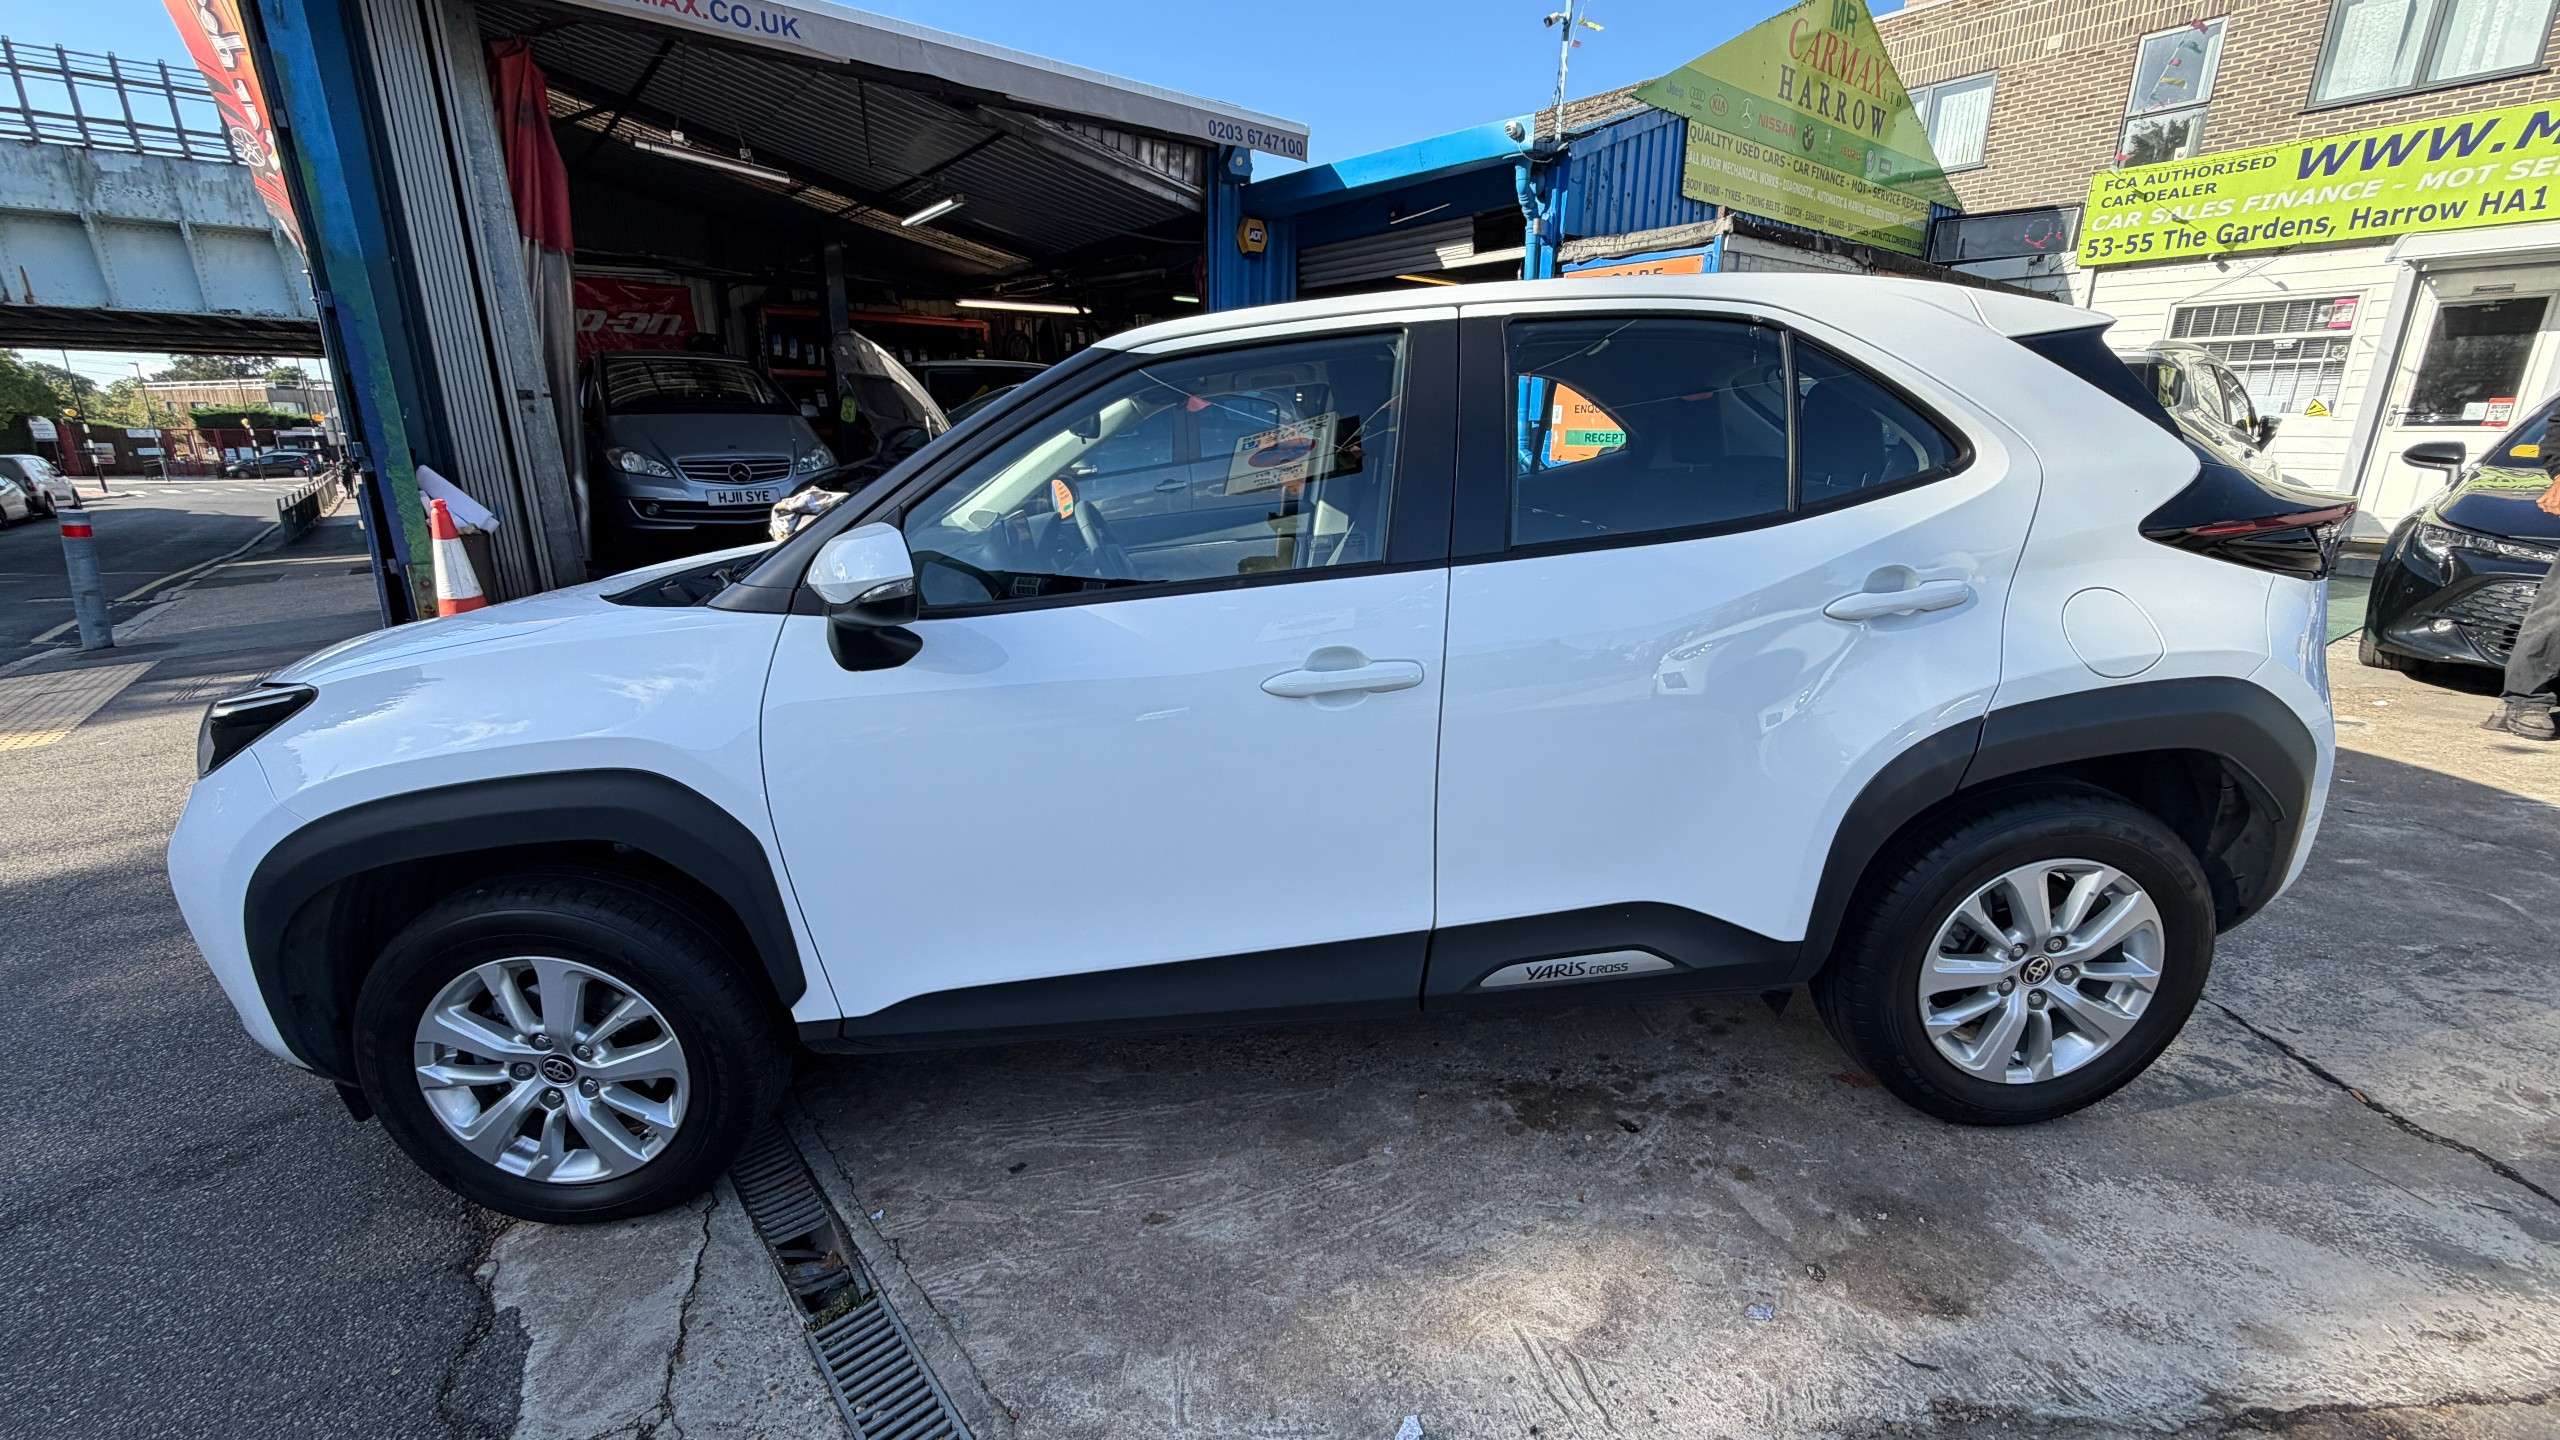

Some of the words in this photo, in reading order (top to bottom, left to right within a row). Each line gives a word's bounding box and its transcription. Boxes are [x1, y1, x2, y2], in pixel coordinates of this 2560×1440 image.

[642, 0, 801, 39] AX.CO.UK
[1831, 0, 1858, 39] MR
[1789, 17, 1889, 99] CARMAX
[1883, 87, 1902, 107] LTD
[1778, 64, 1887, 138] HARROW
[1208, 119, 1243, 142] 0203
[1247, 128, 1304, 157] 6747100
[1759, 112, 1797, 138] NISSAN
[2297, 110, 2560, 181] WWW.M
[1689, 124, 1734, 152] QUALITY
[1736, 140, 1761, 160] USED
[1762, 149, 1785, 168] CARS
[1793, 158, 1810, 176] CAR
[1811, 165, 1846, 188] FINANCE
[1851, 179, 1867, 195] MOT
[1872, 186, 1901, 206] SERVICE
[1902, 196, 1929, 213] REPAIRS
[2104, 176, 2138, 192] FCA
[2143, 155, 2277, 186] AUTHORISED
[1686, 177, 1703, 191] BODY
[1703, 183, 1721, 197] WORK
[1725, 188, 1741, 202] TYRES
[1784, 204, 1802, 218] CLUTCH
[2091, 211, 2143, 232] CAR
[2147, 198, 2233, 226] SALES
[2241, 178, 2385, 214] FINANCE
[2416, 163, 2501, 193] MOT
[2101, 194, 2137, 209] CAR
[2143, 182, 2218, 203] DEALER
[2085, 231, 2155, 259] 53-55
[2164, 228, 2207, 250] The
[2216, 216, 2337, 245] Gardens,
[2349, 200, 2469, 231] Harrow
[2478, 185, 2548, 216] HA1
[717, 491, 743, 504] HJ11
[746, 490, 771, 503] SYE
[1588, 962, 1629, 975] CROSS
